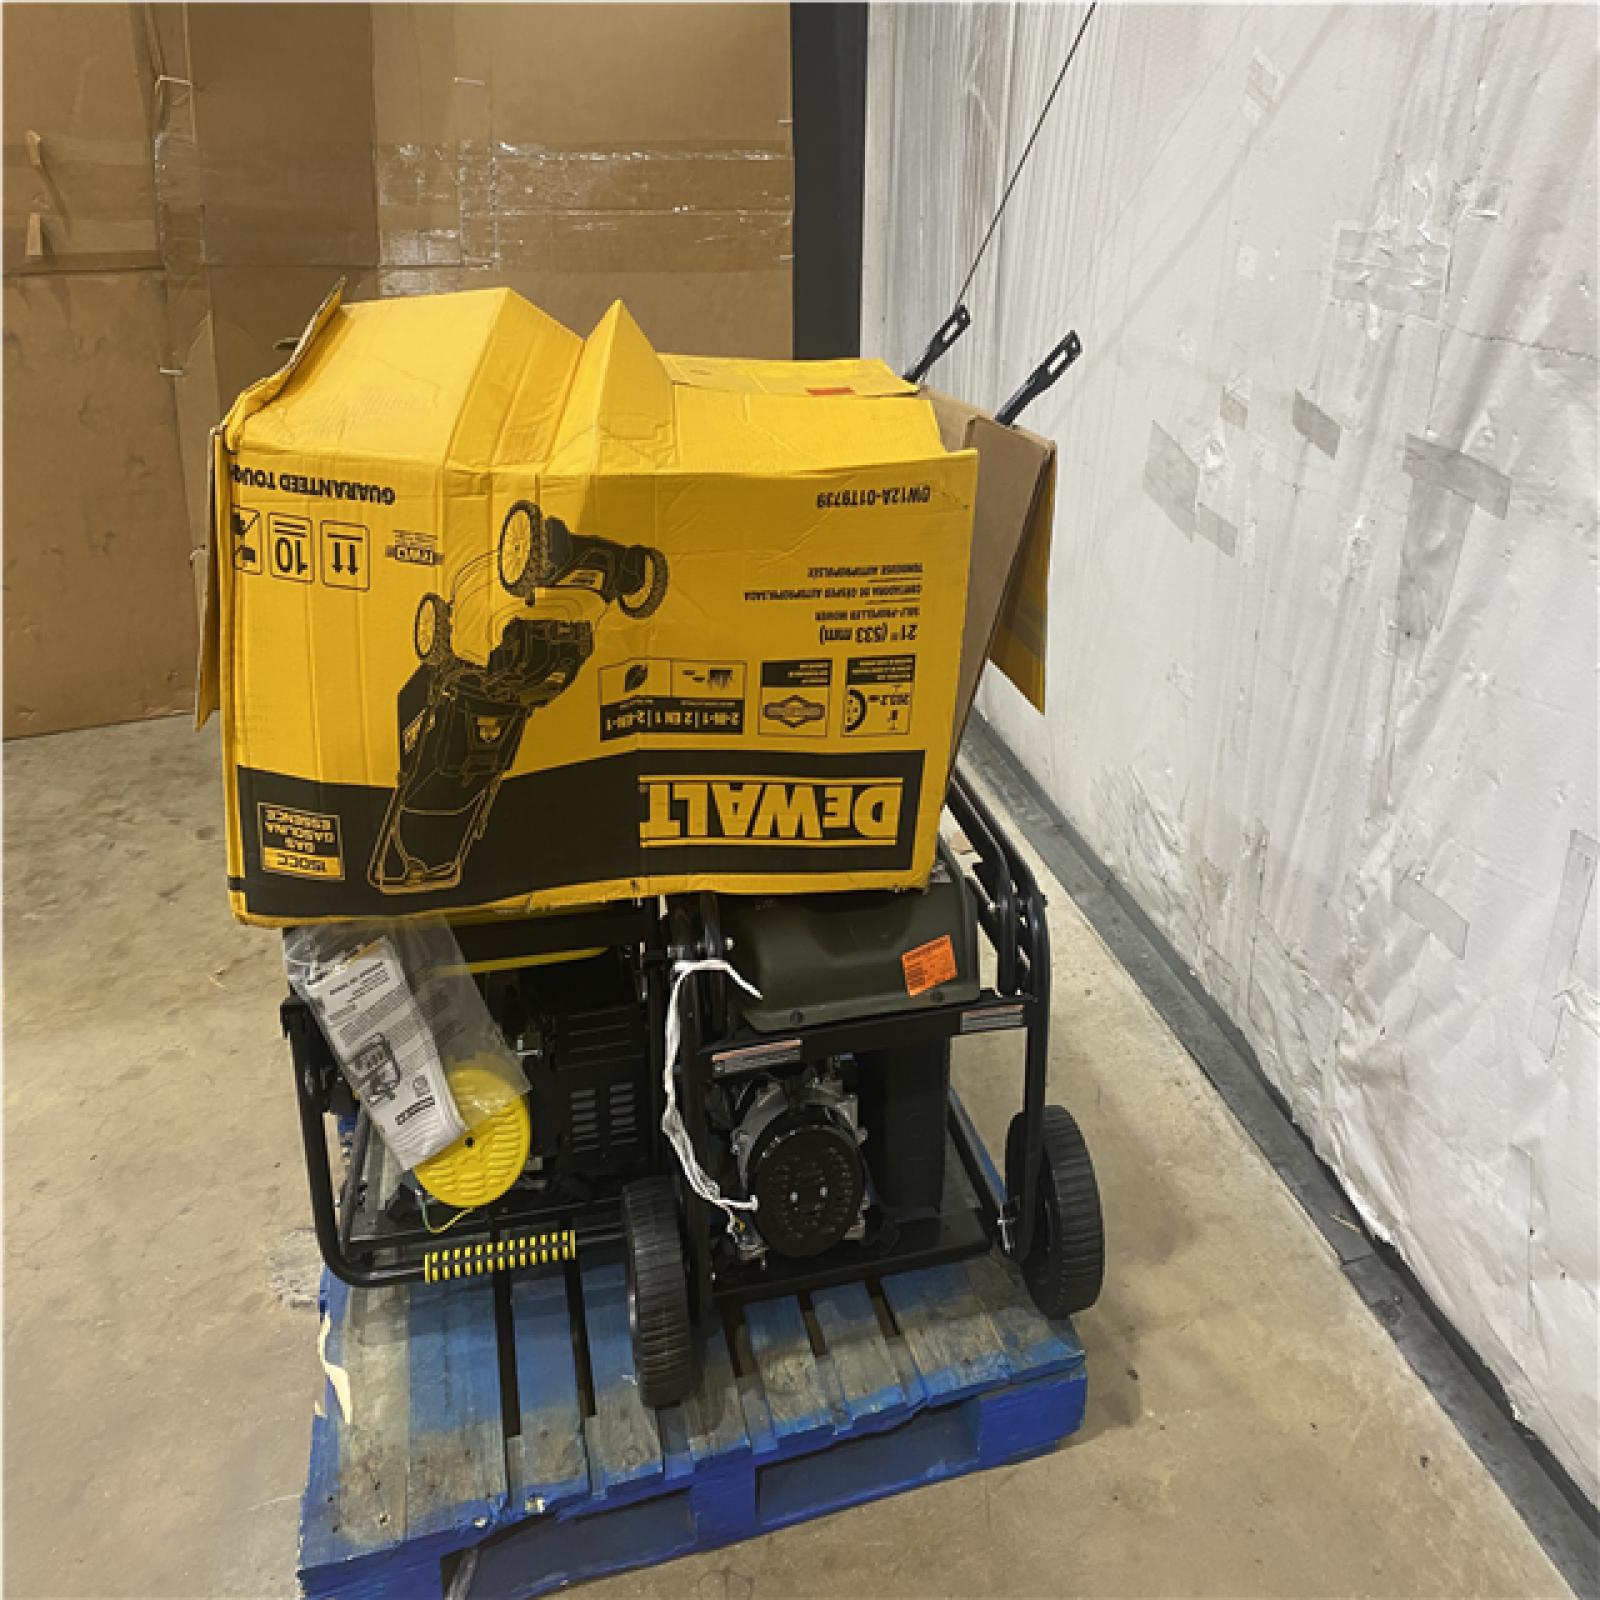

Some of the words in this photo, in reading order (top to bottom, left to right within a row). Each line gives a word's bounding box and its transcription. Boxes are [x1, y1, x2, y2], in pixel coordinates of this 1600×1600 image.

[280, 474, 396, 506] GUARANTEED
[275, 537, 308, 575] 10
[859, 587, 872, 598] DE
[814, 610, 848, 622] MOWER
[819, 625, 853, 645] mm)
[856, 622, 888, 643] (533
[639, 783, 902, 839] DEWALT
[284, 837, 315, 853] GAS
